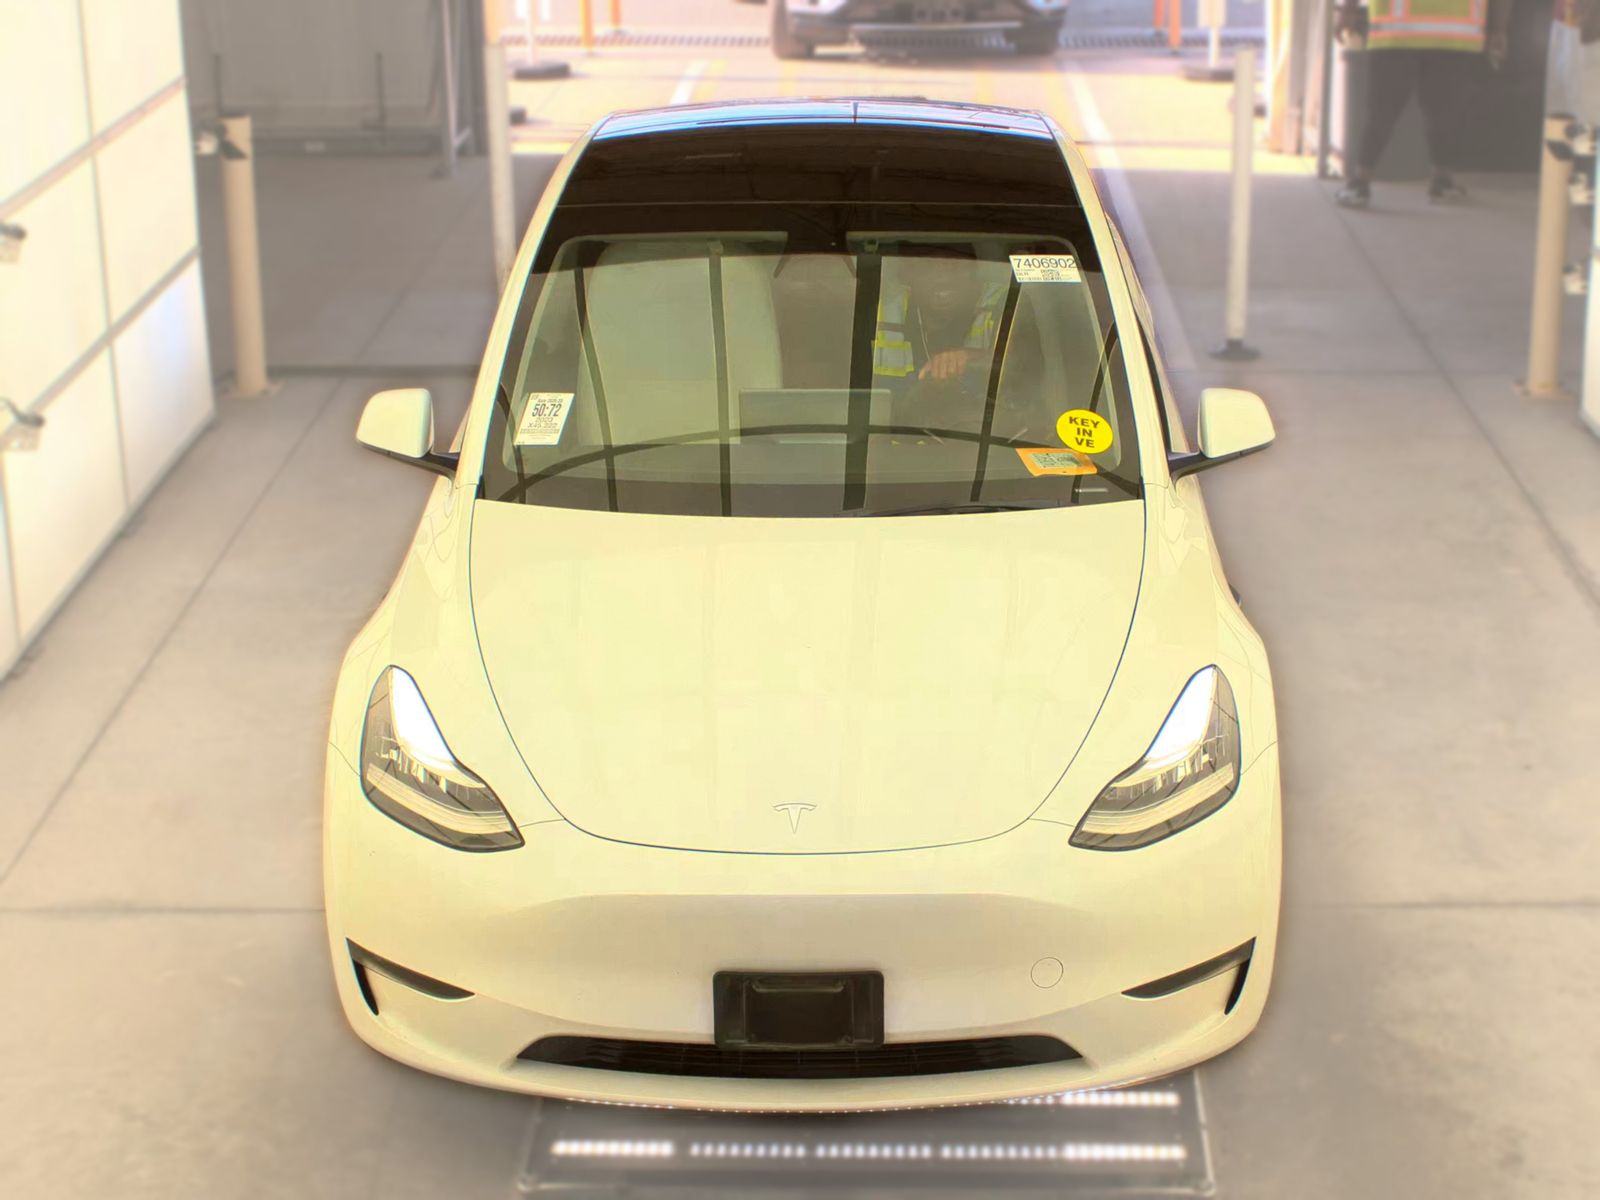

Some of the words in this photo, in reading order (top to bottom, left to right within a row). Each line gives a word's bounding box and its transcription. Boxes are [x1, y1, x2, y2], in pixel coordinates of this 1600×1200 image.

[1014, 258, 1077, 268] 7406902
[532, 403, 562, 417] 50:72
[1069, 416, 1100, 429] KEY
[1076, 427, 1093, 438] IN
[1074, 437, 1095, 448] VE
